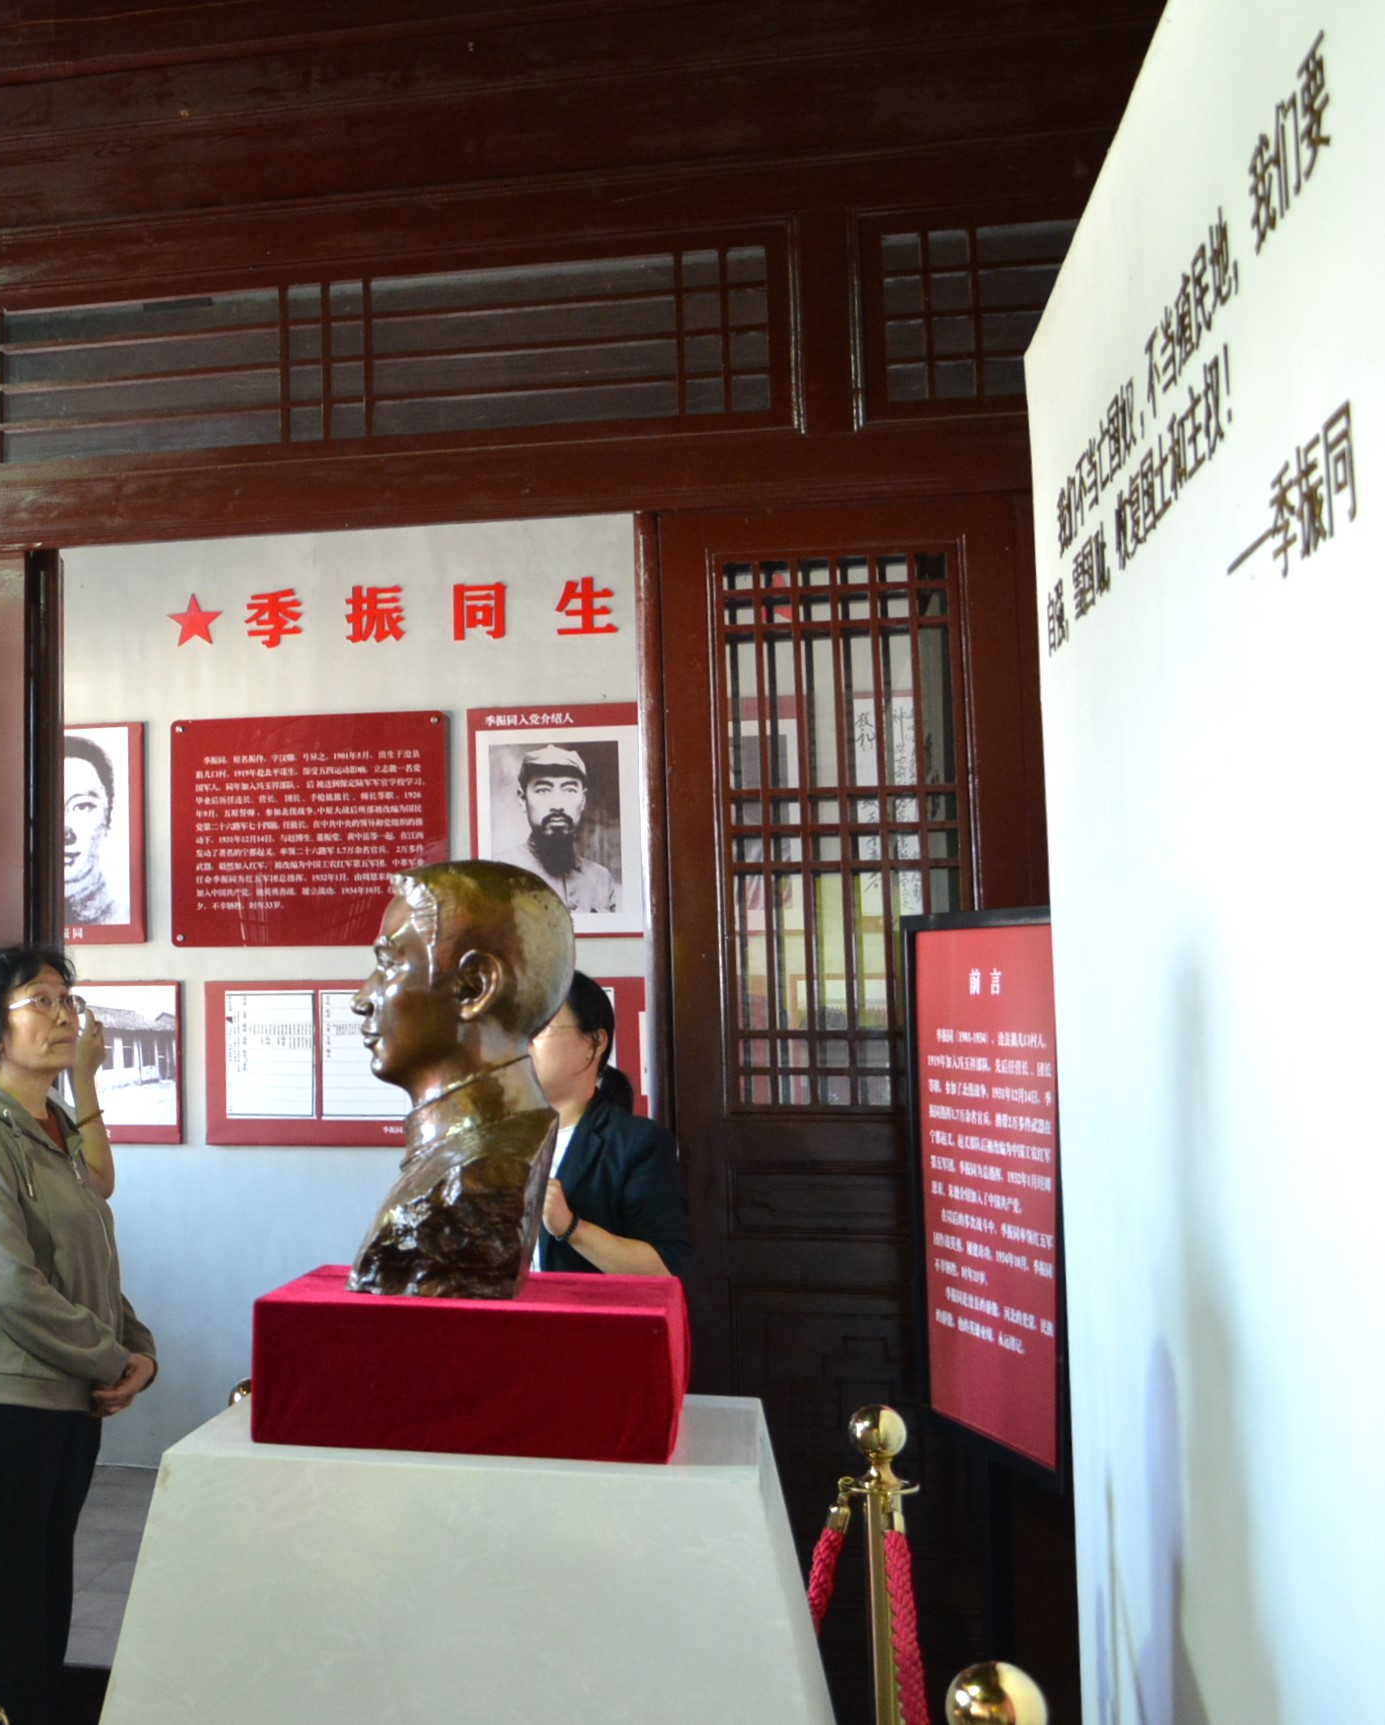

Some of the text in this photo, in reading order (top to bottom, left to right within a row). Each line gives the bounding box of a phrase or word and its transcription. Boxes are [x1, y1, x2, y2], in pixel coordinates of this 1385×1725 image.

[244, 577, 618, 648] 季振同生
[485, 712, 574, 727] 季振同入党介绍人
[968, 968, 1002, 996] 前言
